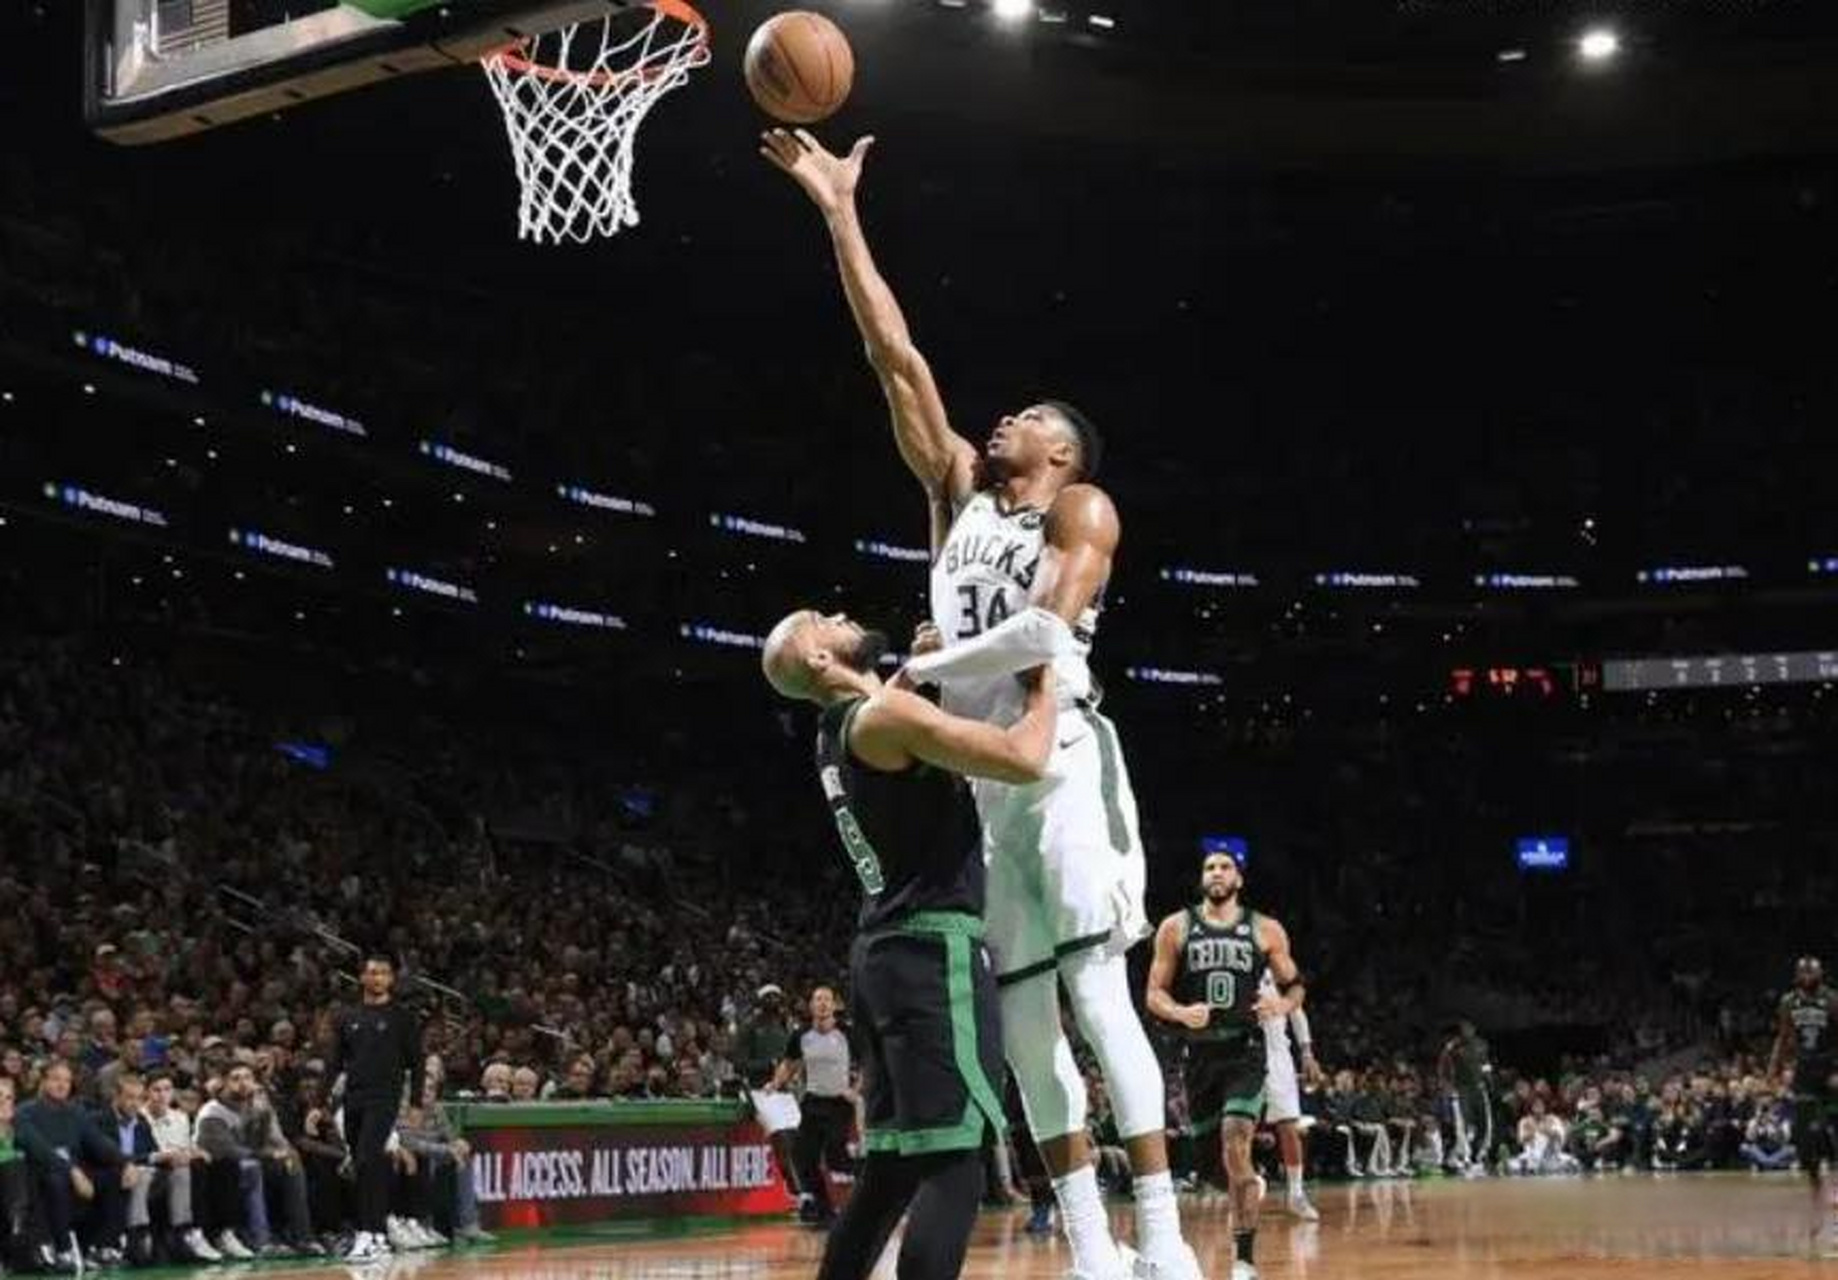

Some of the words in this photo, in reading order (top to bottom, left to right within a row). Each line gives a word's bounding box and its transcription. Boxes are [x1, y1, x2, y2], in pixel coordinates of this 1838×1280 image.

[737, 517, 784, 537] Putnam
[707, 628, 755, 647] Putnam
[1187, 937, 1254, 973] CELTICS
[1206, 971, 1236, 1010] 0
[473, 1151, 506, 1202] ALL
[509, 1150, 586, 1201] ACCESS.
[591, 1148, 623, 1196] ALL
[701, 1146, 729, 1190] ALL
[731, 1144, 775, 1189] HERE
